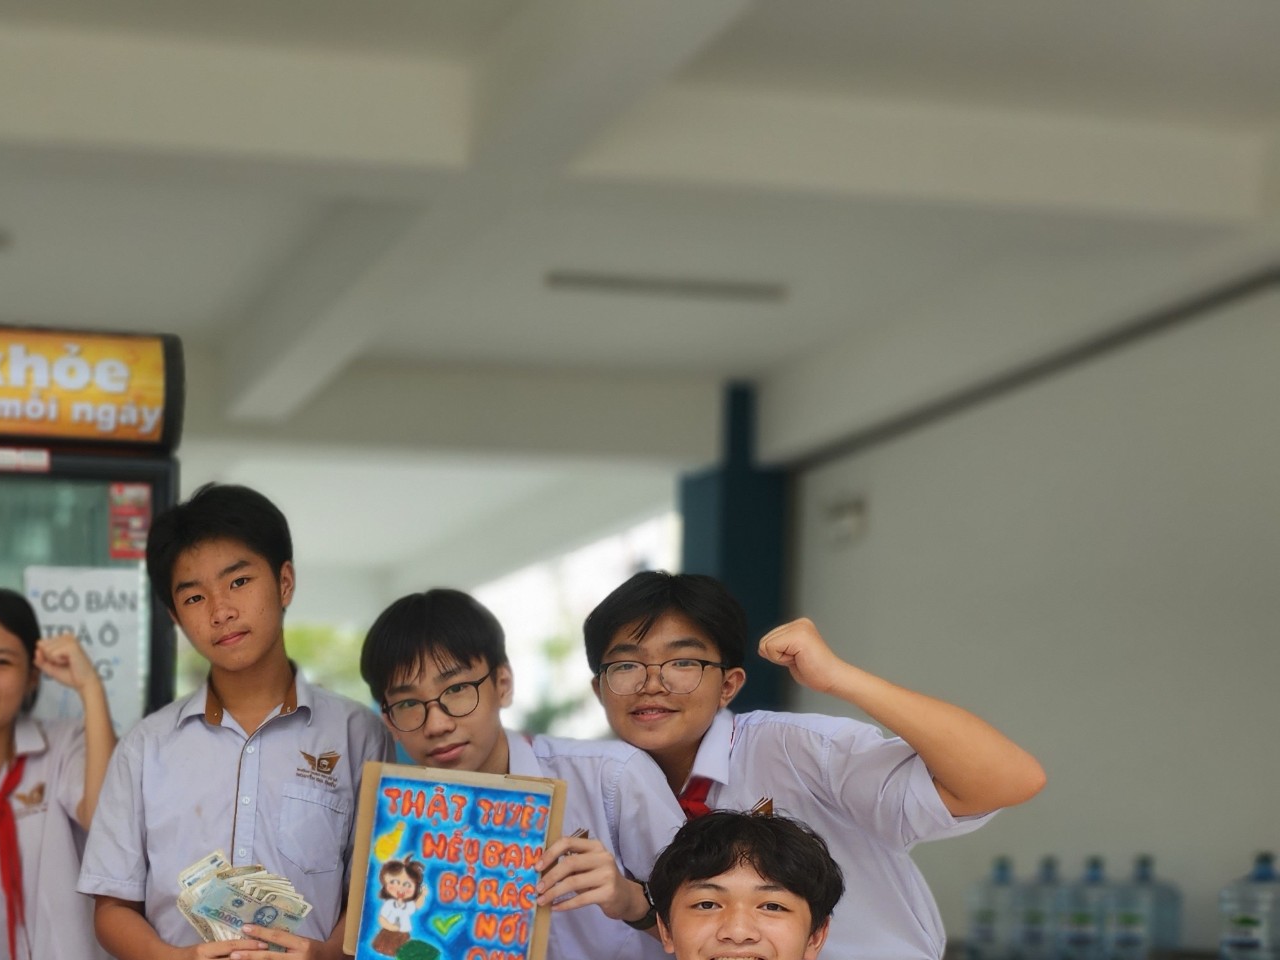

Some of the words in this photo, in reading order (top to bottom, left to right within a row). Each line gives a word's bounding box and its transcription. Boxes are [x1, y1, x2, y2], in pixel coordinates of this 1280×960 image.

[384, 786, 467, 826] THẬT
[477, 796, 549, 837] TUYỆT
[422, 825, 480, 865] NẾU
[482, 840, 542, 877] BẠN
[477, 876, 536, 910] RÁC
[474, 911, 528, 945] NƠI
